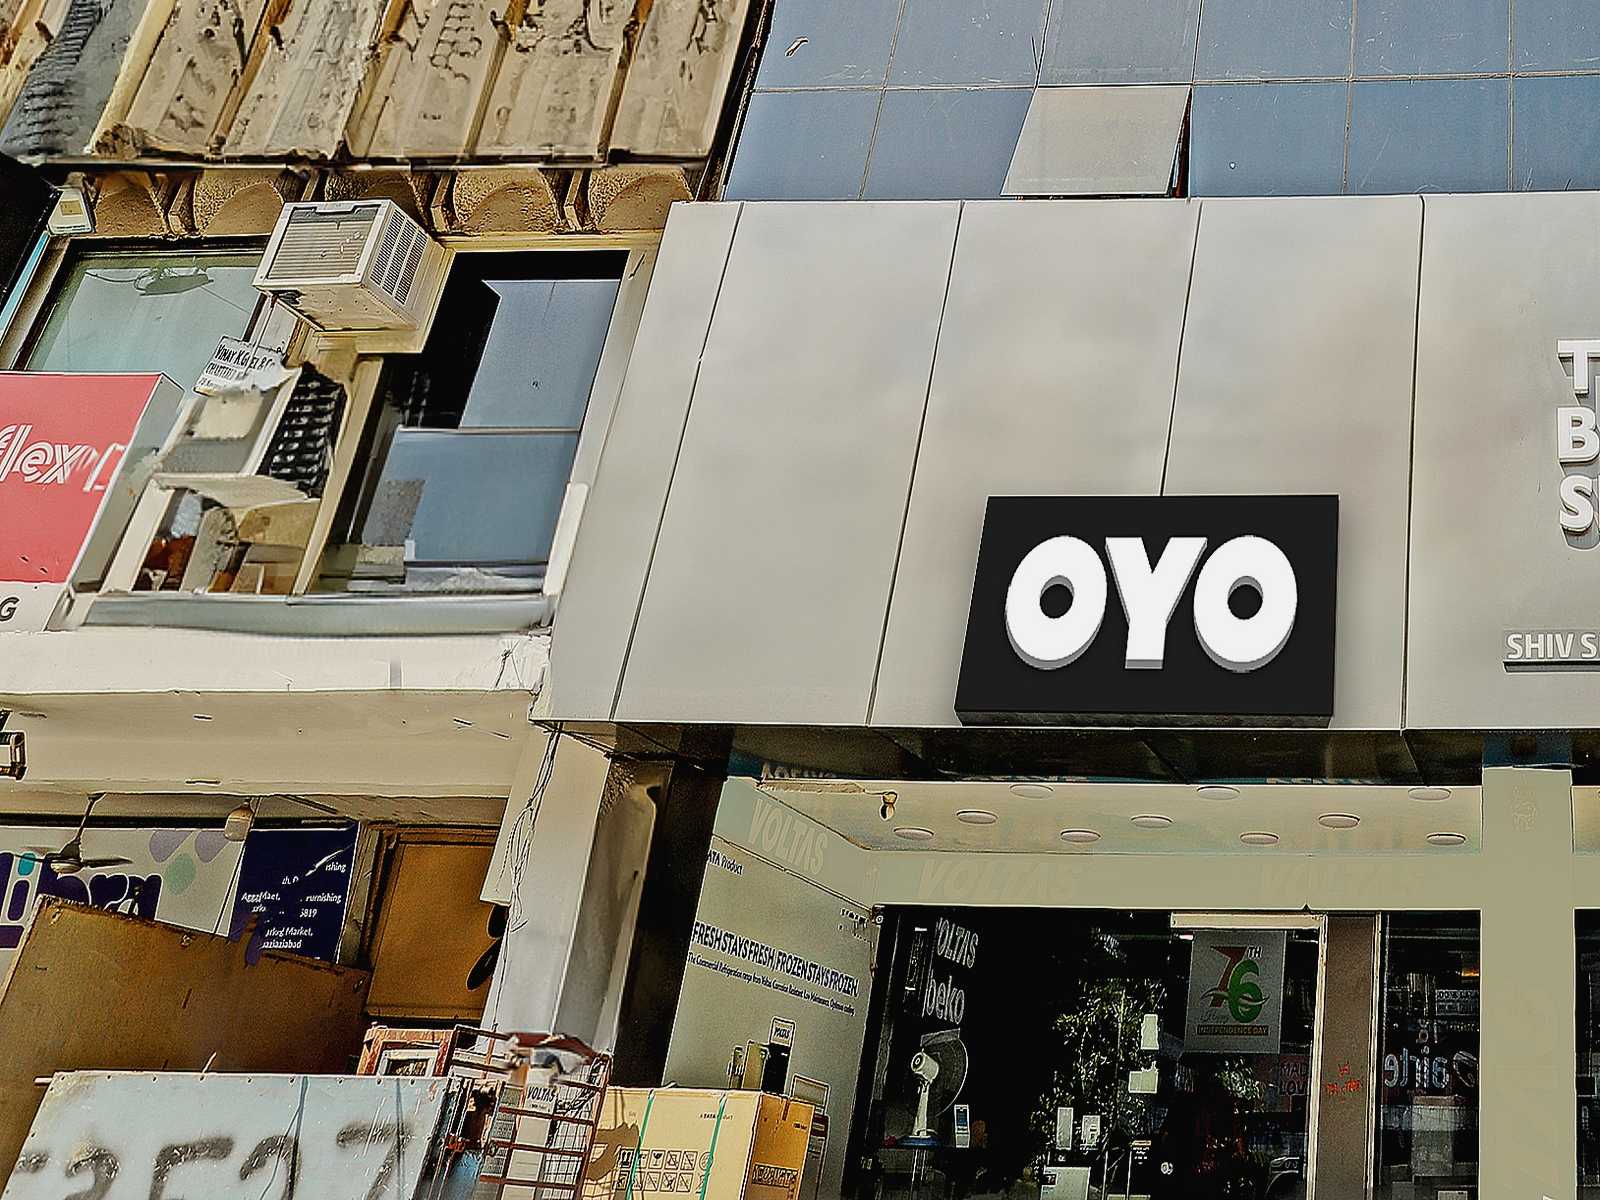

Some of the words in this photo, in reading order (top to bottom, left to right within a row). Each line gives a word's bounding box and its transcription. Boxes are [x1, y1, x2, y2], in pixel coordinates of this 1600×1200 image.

[1004, 534, 1299, 674] OYO
[1506, 632, 1575, 660] SHIV
[692, 920, 722, 951] FRESH
[721, 931, 750, 960] STAYS
[776, 950, 808, 979] FROZEN
[806, 962, 831, 988] STAYS
[926, 969, 966, 1025] beko
[527, 1085, 557, 1101] VOLTAS
